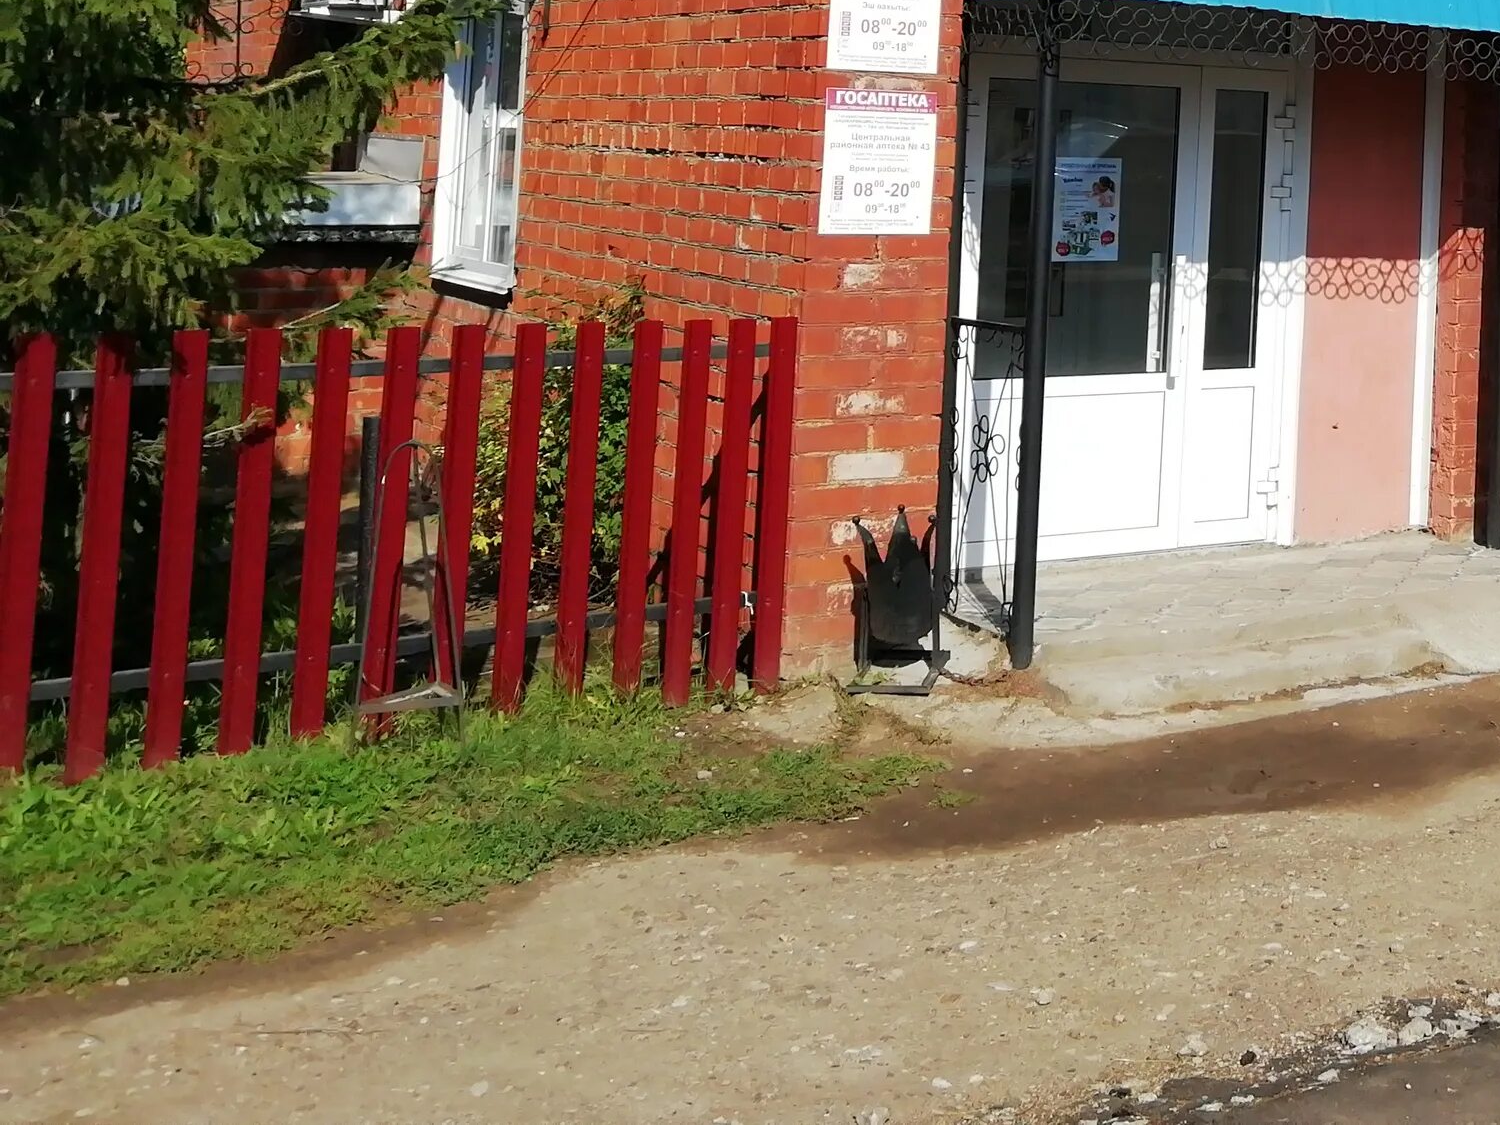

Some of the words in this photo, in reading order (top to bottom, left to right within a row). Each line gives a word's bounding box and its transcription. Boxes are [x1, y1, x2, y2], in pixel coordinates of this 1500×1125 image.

[862, 1, 874, 9] Эш
[836, 91, 928, 107] ГОСАПТЕКА
[851, 133, 911, 143] Центральная
[830, 142, 874, 151] районная
[875, 143, 906, 151] аптека
[920, 143, 930, 151] 43
[849, 164, 876, 173] Время
[877, 165, 911, 174] работы:
